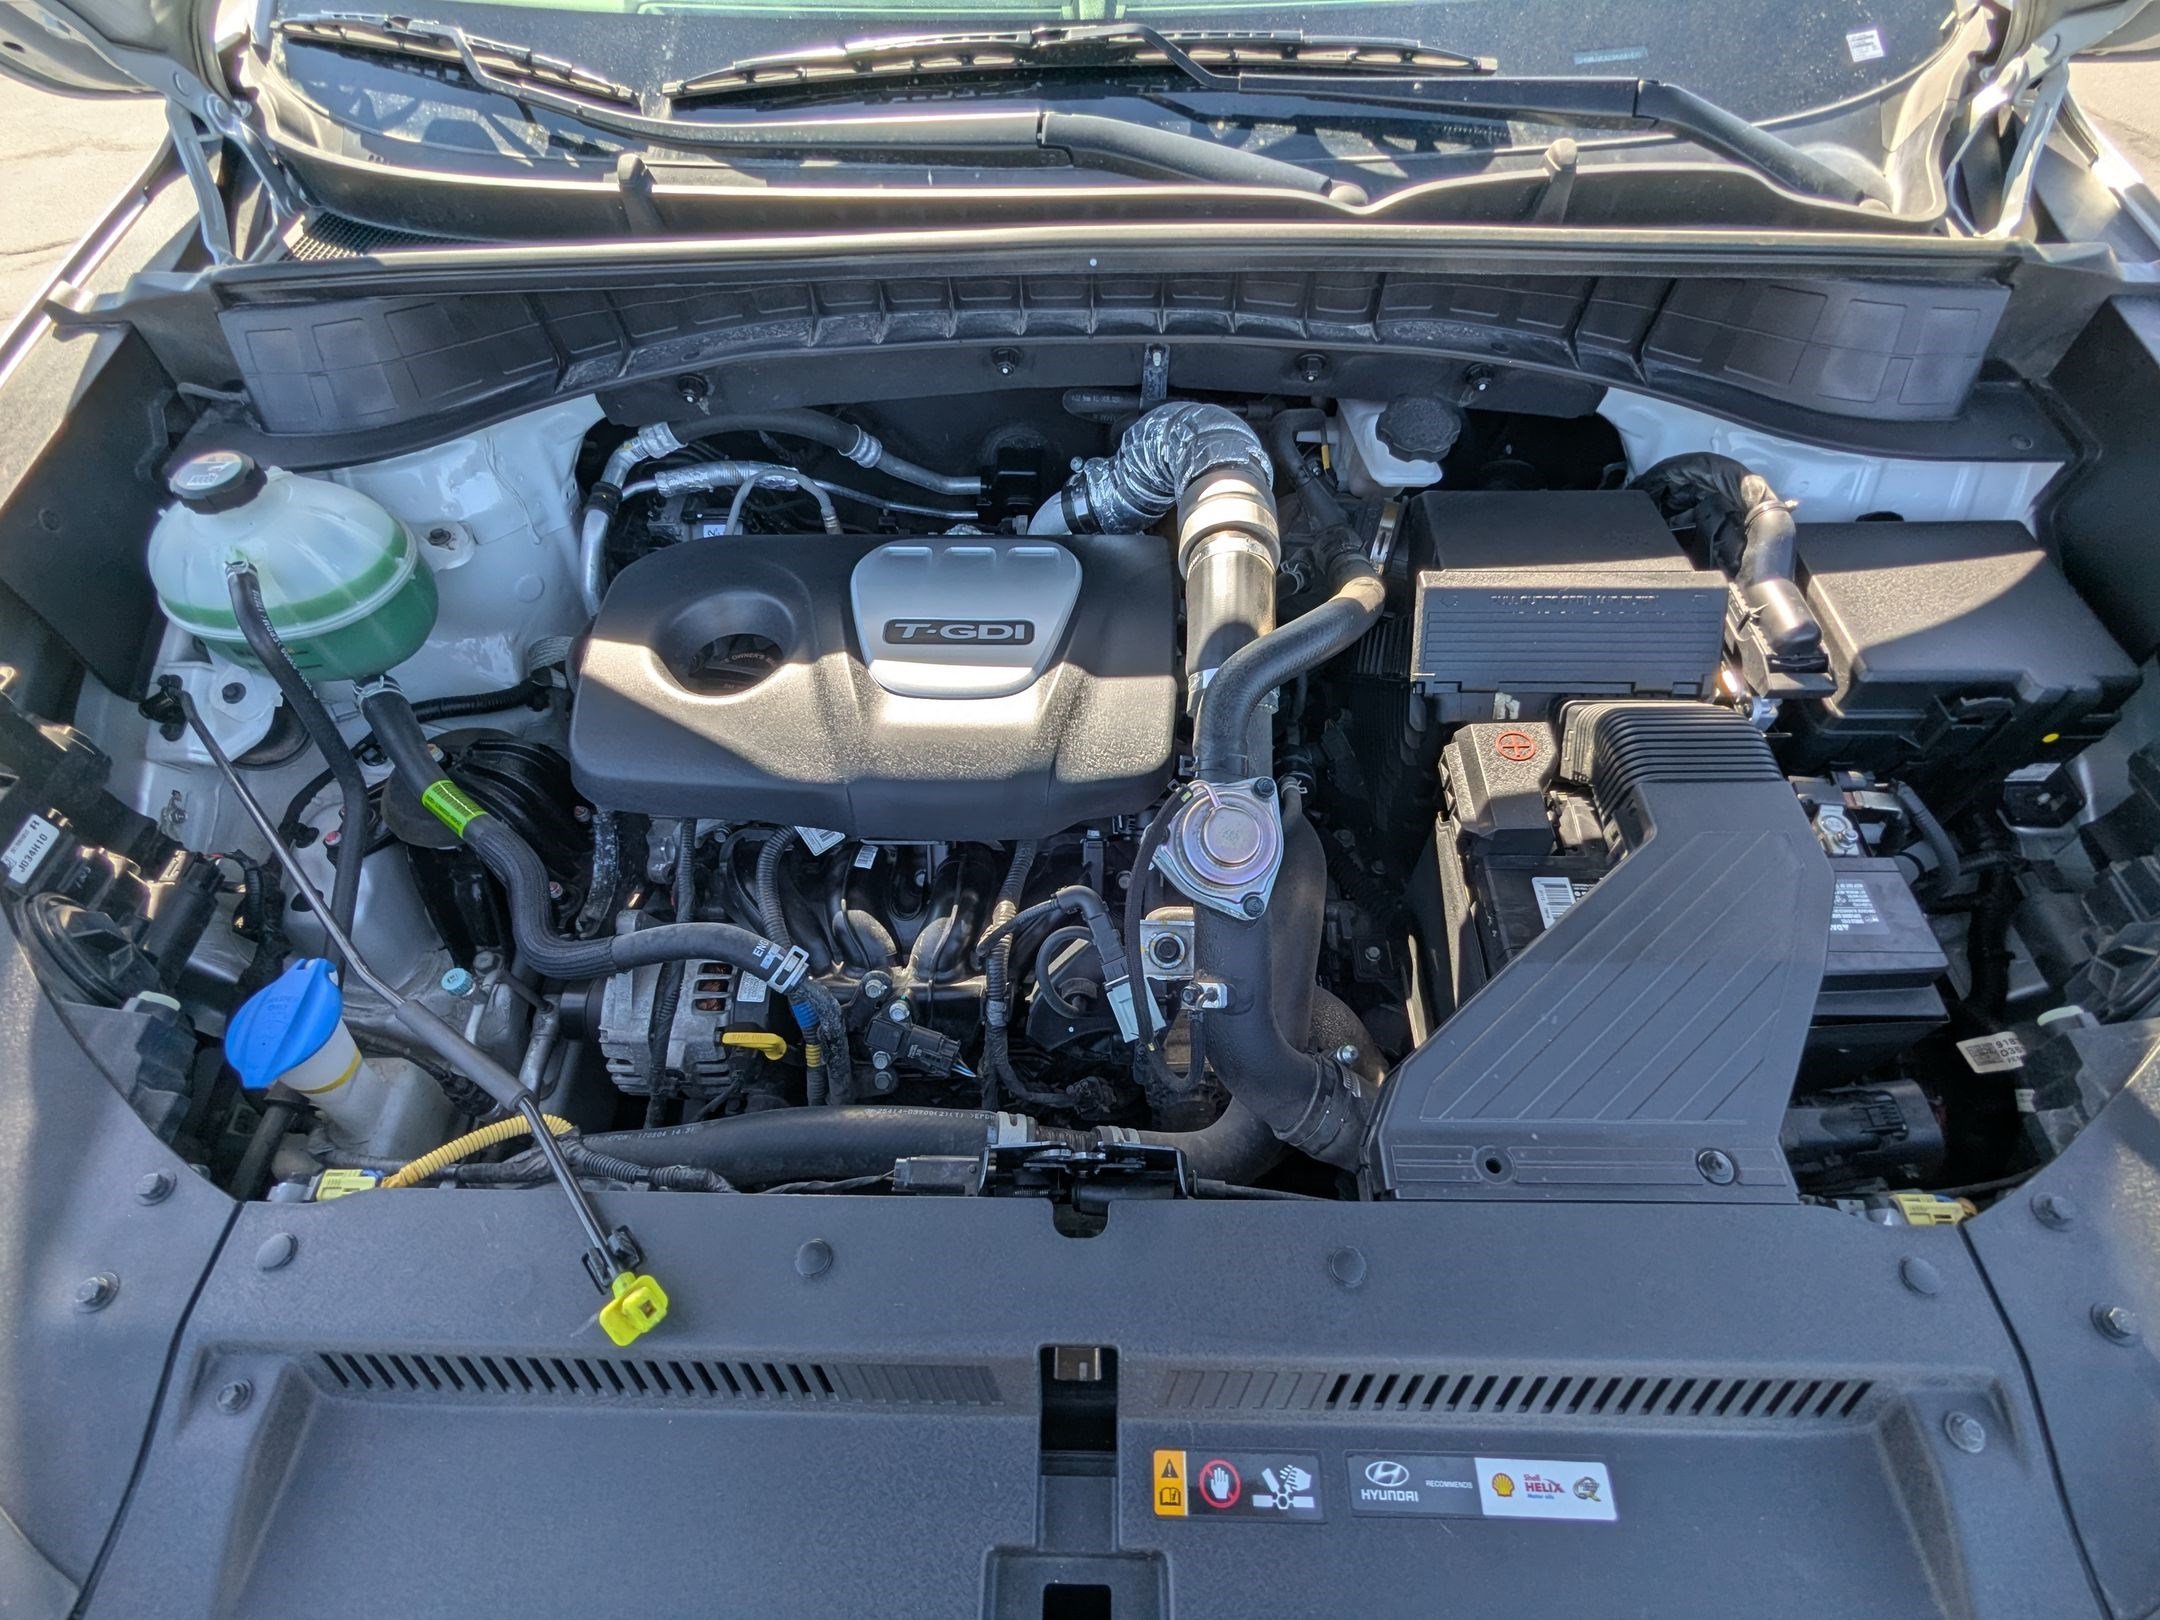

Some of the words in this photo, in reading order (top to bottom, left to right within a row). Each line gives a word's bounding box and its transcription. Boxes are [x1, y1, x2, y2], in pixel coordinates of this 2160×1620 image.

[894, 623, 1026, 641] T-GDI
[1425, 1479, 1473, 1489] RECOMMENDS
[1523, 1473, 1541, 1482] Shell
[1525, 1479, 1565, 1493] HELIX
[1361, 1488, 1419, 1502] HYUNDAI
